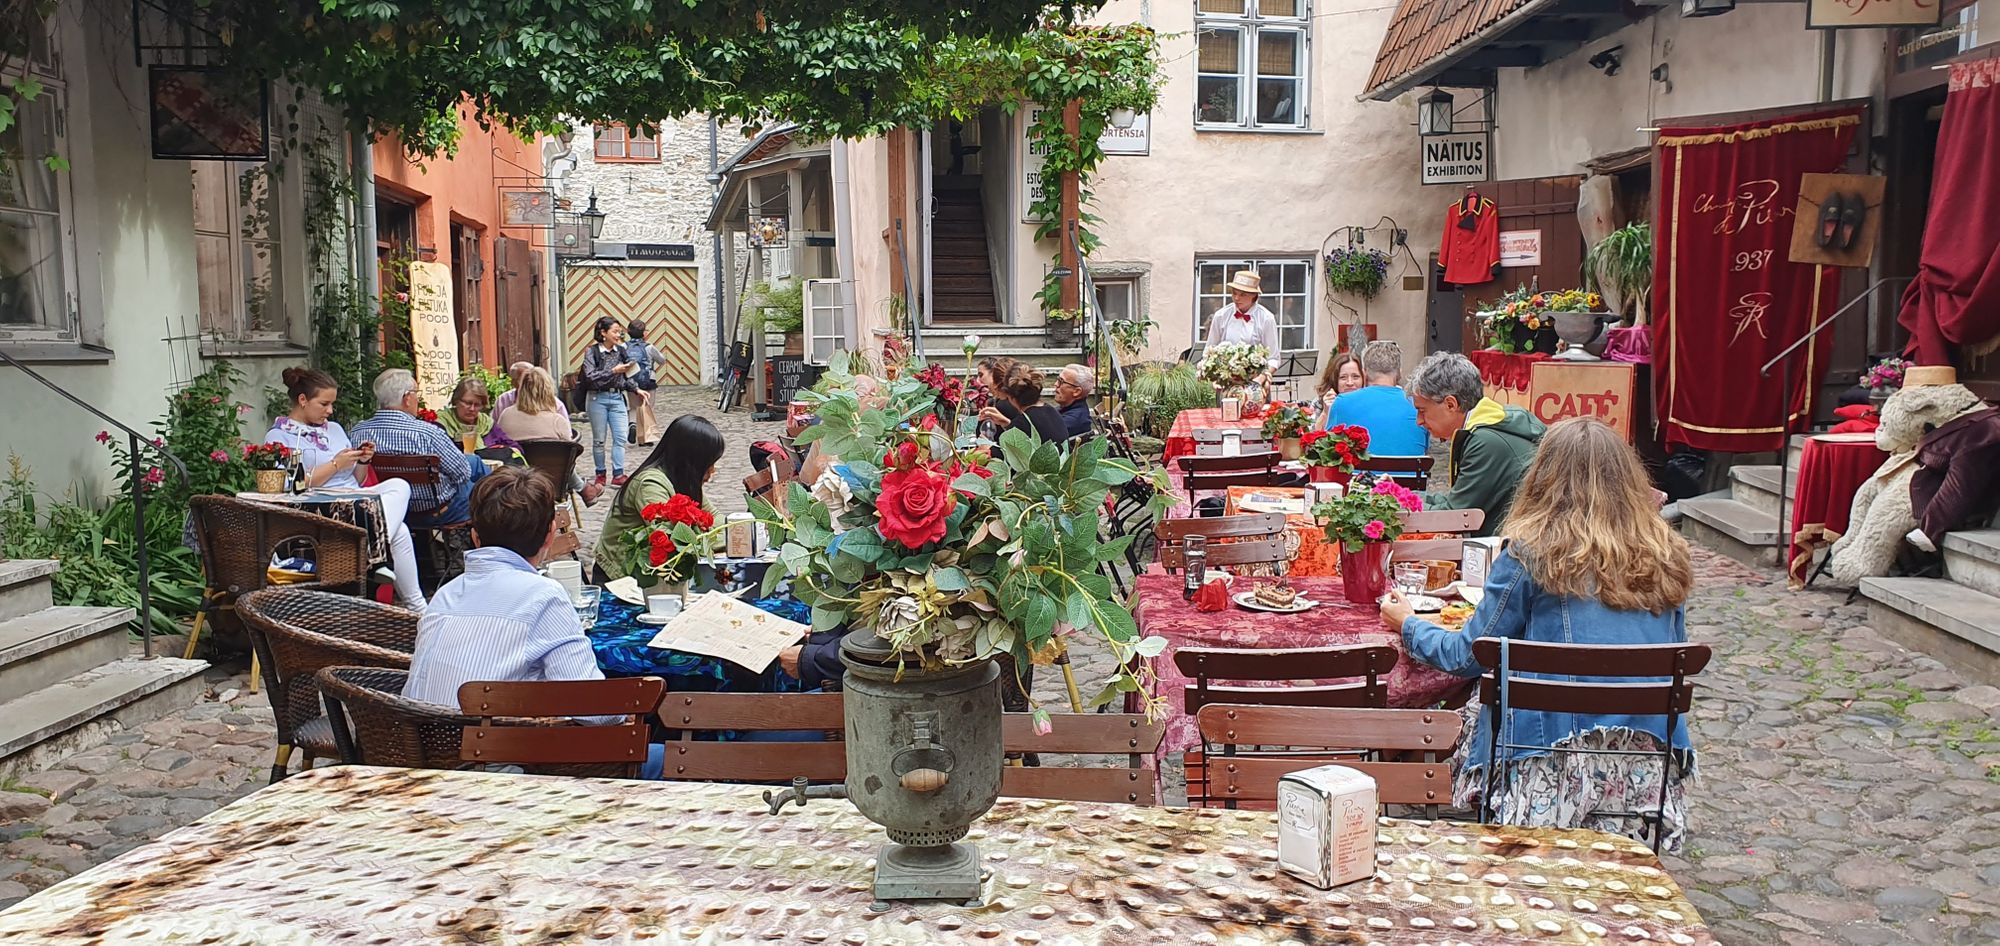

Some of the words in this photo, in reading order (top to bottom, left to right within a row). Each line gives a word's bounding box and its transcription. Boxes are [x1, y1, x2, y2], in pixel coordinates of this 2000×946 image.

[1427, 139, 1483, 162] NÄITUS
[1427, 164, 1483, 177] EXHIBITION
[1729, 249, 1775, 272] 937
[419, 313, 450, 324] POOD
[423, 350, 452, 360] WOOD
[778, 360, 805, 374] CERAMIC
[424, 371, 454, 385] DESIGN
[782, 374, 800, 388] SHOP
[1534, 389, 1619, 426] CAFÉ
